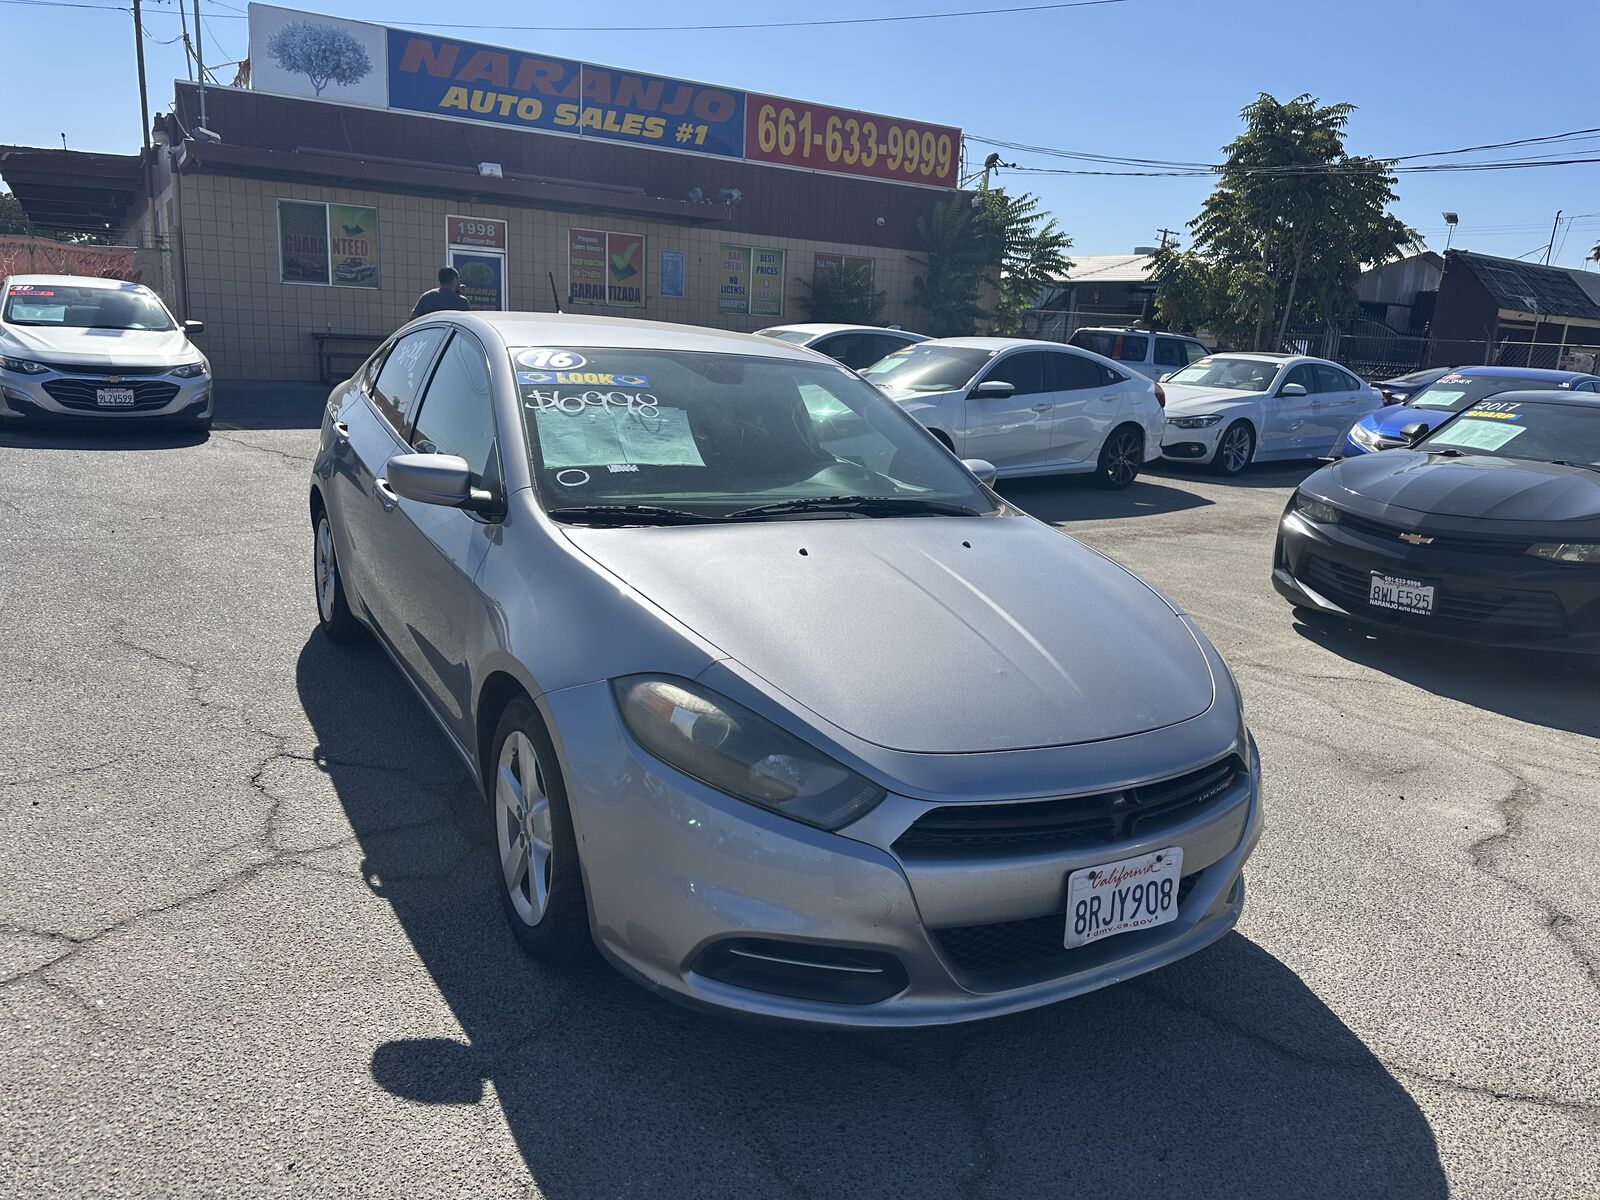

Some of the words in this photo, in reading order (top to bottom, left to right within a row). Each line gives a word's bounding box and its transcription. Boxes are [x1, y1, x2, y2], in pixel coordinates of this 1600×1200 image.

[400, 37, 737, 122] NARANJO
[439, 86, 544, 120] AUTO
[553, 102, 667, 139] SALES
[674, 121, 710, 145] #1
[757, 104, 951, 179] 661-633-9999
[457, 221, 496, 237] 1998
[722, 260, 746, 272] CREDIT
[760, 253, 776, 264] BEST
[756, 265, 778, 276] PRICES
[729, 275, 738, 285] NO
[571, 282, 641, 303] GARANTIZADA
[720, 285, 747, 296] LICENSE
[532, 350, 574, 368] 16
[555, 371, 616, 385] LOOK
[524, 389, 660, 418] $6998
[1473, 401, 1522, 412] 2017
[1369, 598, 1398, 609] NARANJO
[1372, 585, 1430, 610] 8WLE595
[1091, 863, 1160, 890] California
[1074, 877, 1174, 936] 8RJY908
[1093, 917, 1154, 938] dmv.ca.gov
